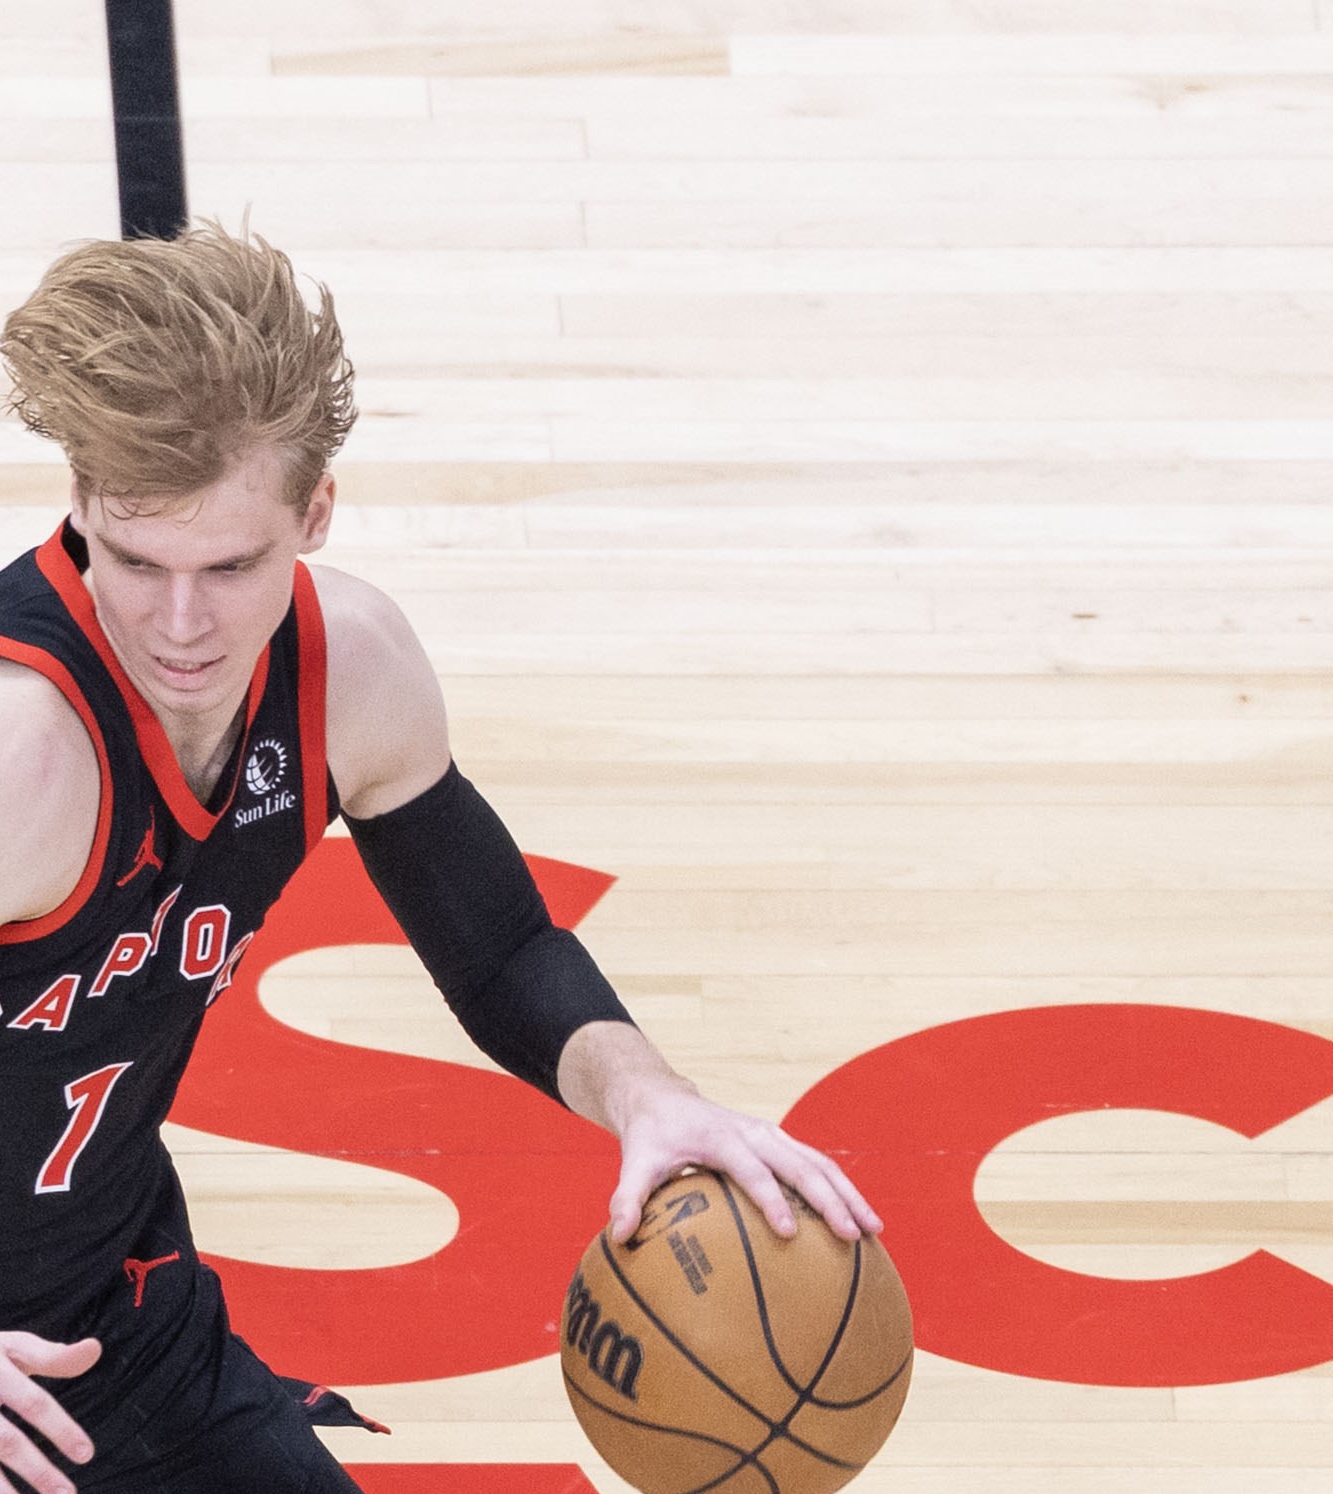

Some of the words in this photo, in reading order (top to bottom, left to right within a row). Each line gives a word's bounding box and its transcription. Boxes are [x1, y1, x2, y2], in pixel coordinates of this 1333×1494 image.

[234, 805, 263, 829] Sun
[264, 789, 296, 816] Life
[34, 1060, 134, 1195] 1
